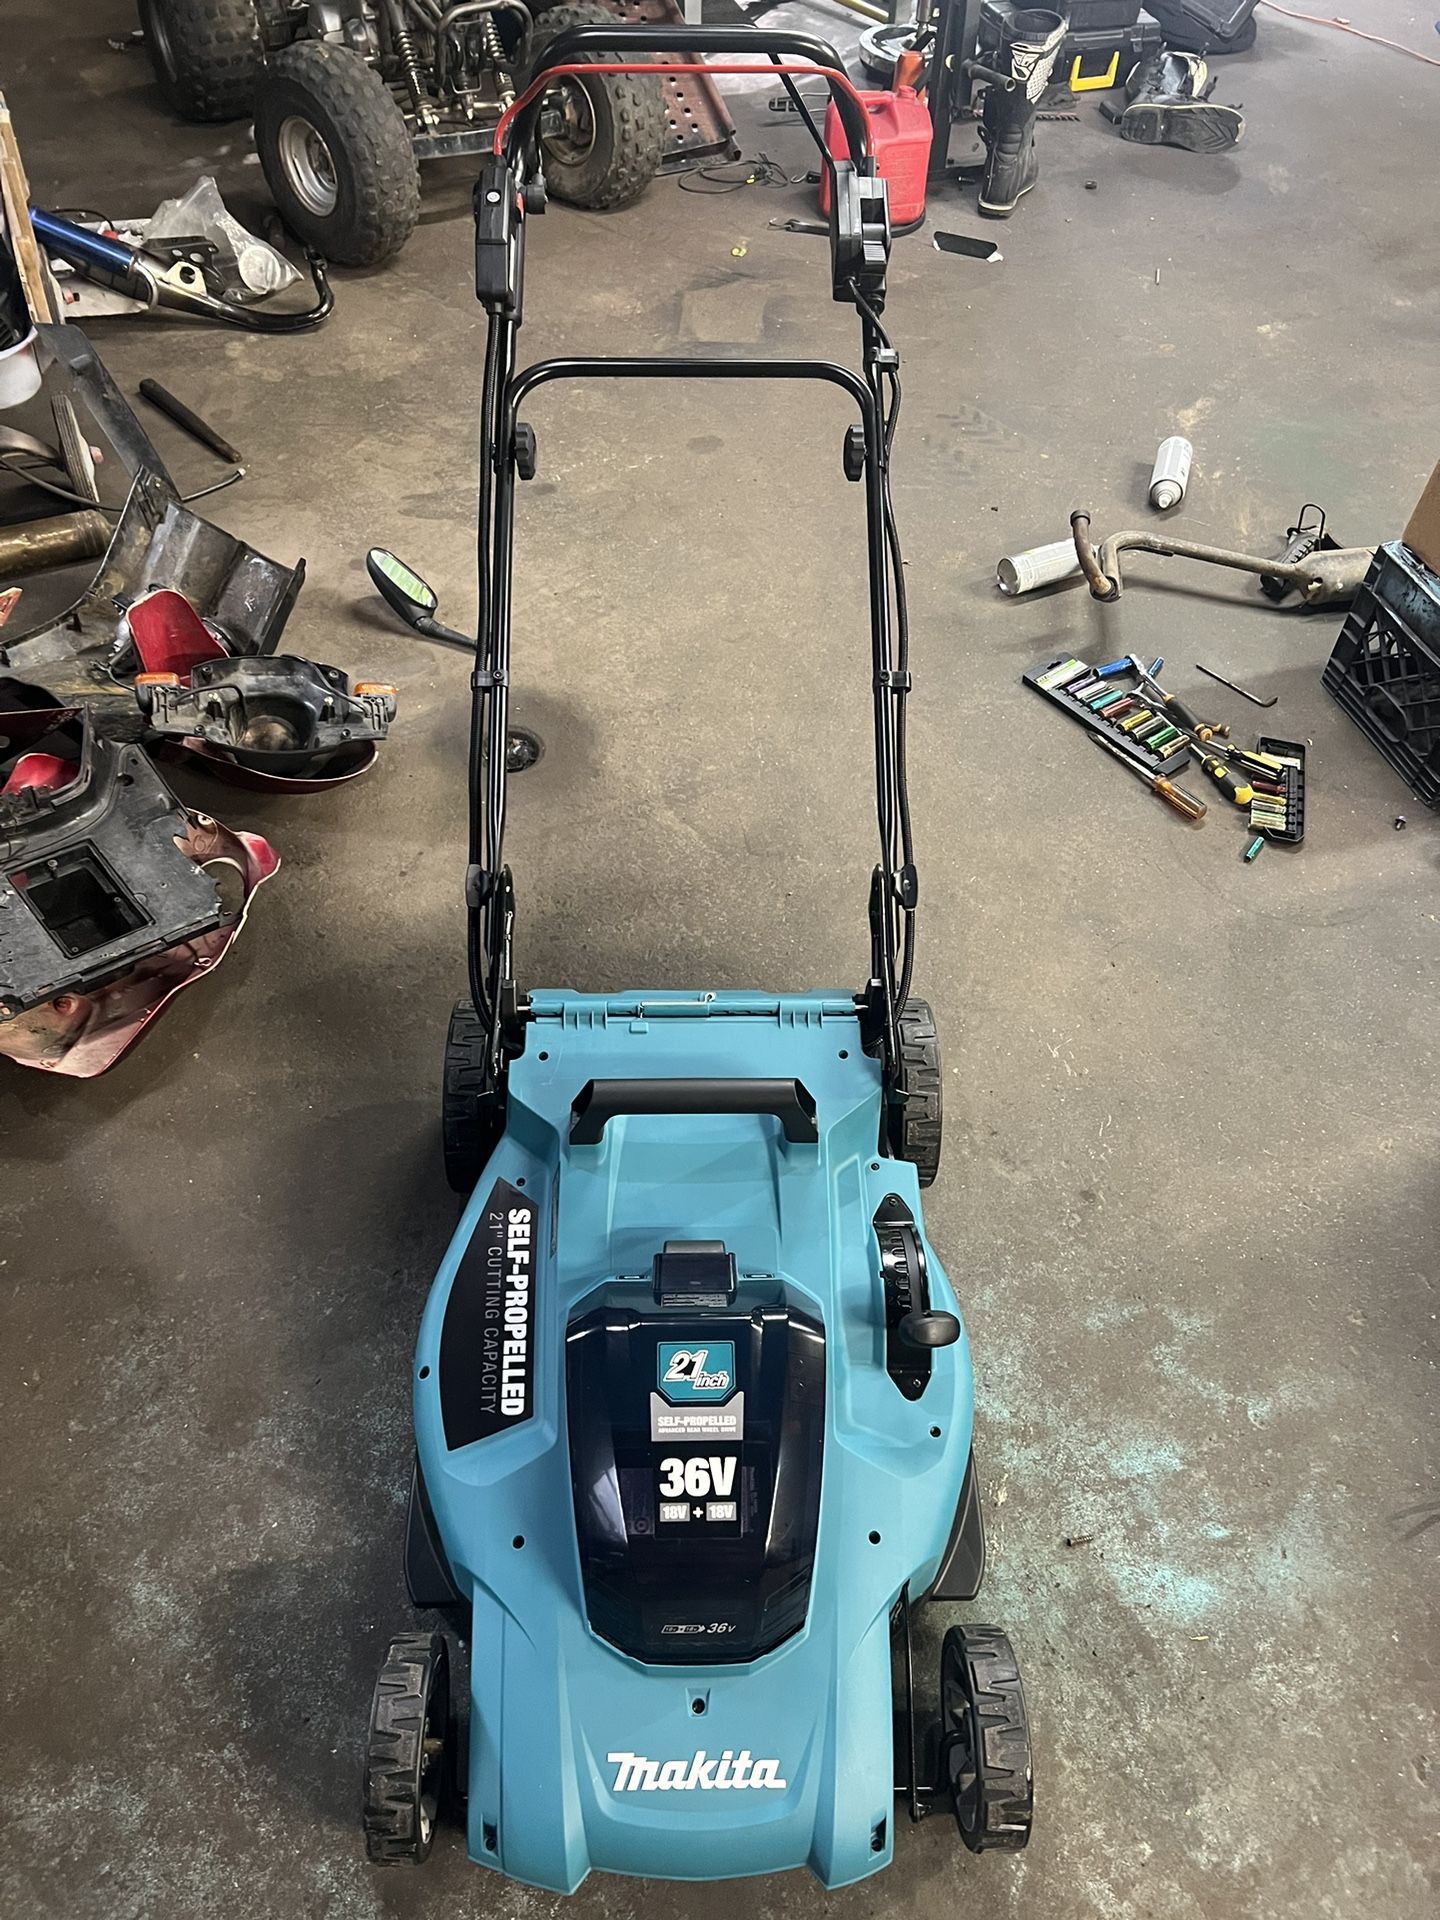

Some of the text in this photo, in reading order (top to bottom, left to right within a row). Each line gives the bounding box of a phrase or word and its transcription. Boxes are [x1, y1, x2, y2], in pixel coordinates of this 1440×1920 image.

[480, 1212, 504, 1414] 21" CUTTING CAPACITY
[501, 1208, 531, 1416] SELF-PROPELLED
[664, 1350, 729, 1389] 21 inch
[657, 1415, 736, 1426] SELF-PROPELLED
[659, 1456, 737, 1497] 36V
[663, 1505, 687, 1519] 18V
[709, 1504, 734, 1518] 18V
[607, 1750, 787, 1792] Makita
